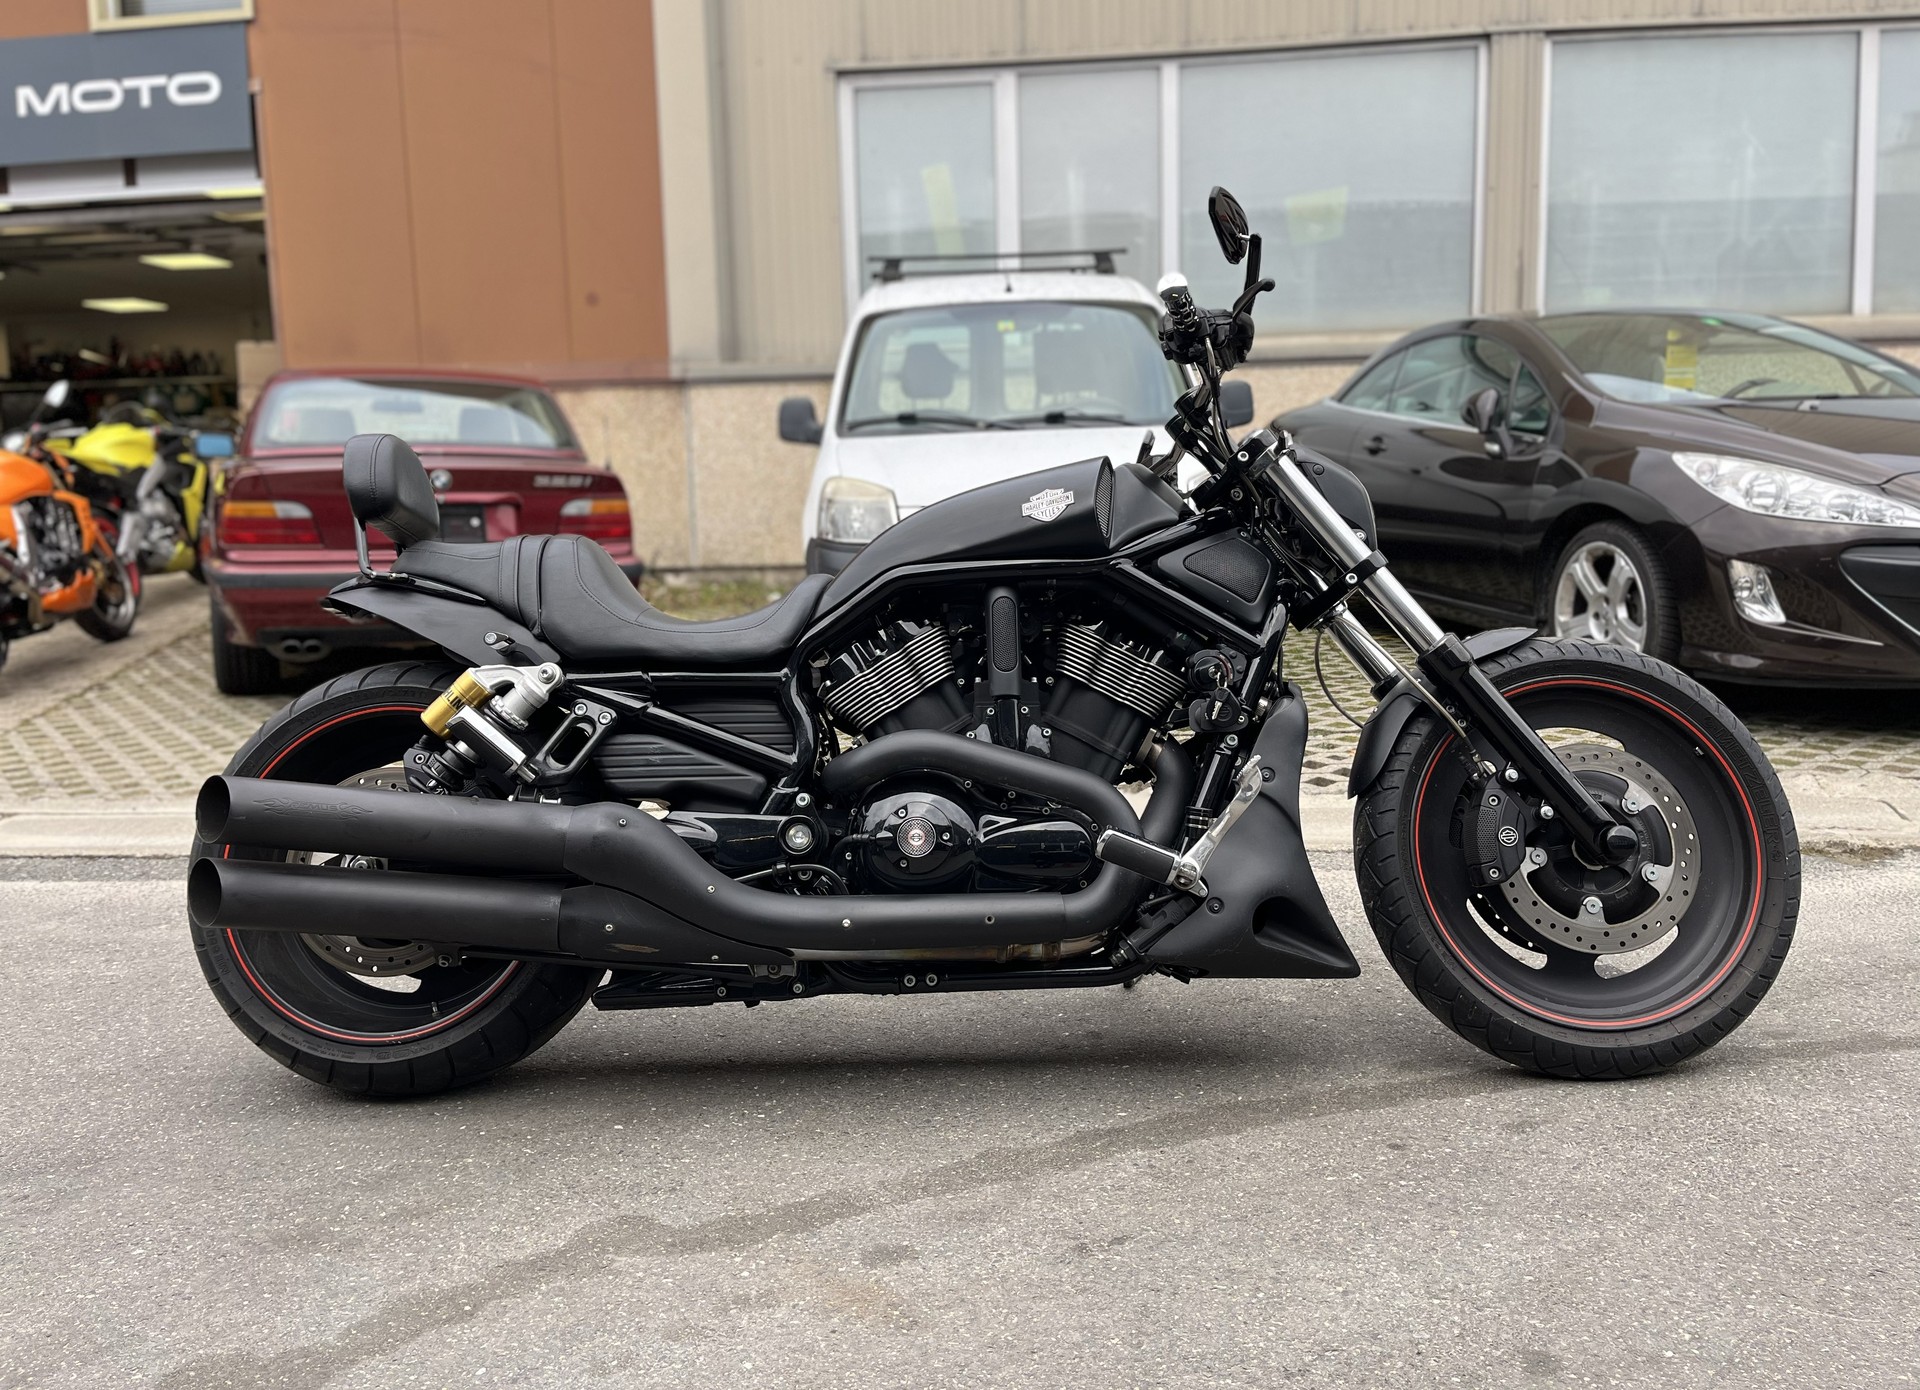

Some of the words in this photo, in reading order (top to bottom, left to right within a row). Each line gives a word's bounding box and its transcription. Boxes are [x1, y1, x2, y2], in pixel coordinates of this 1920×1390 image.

[15, 71, 222, 118] MOTO
[443, 688, 466, 711] HLIN
[1713, 727, 1779, 844] METZELER
